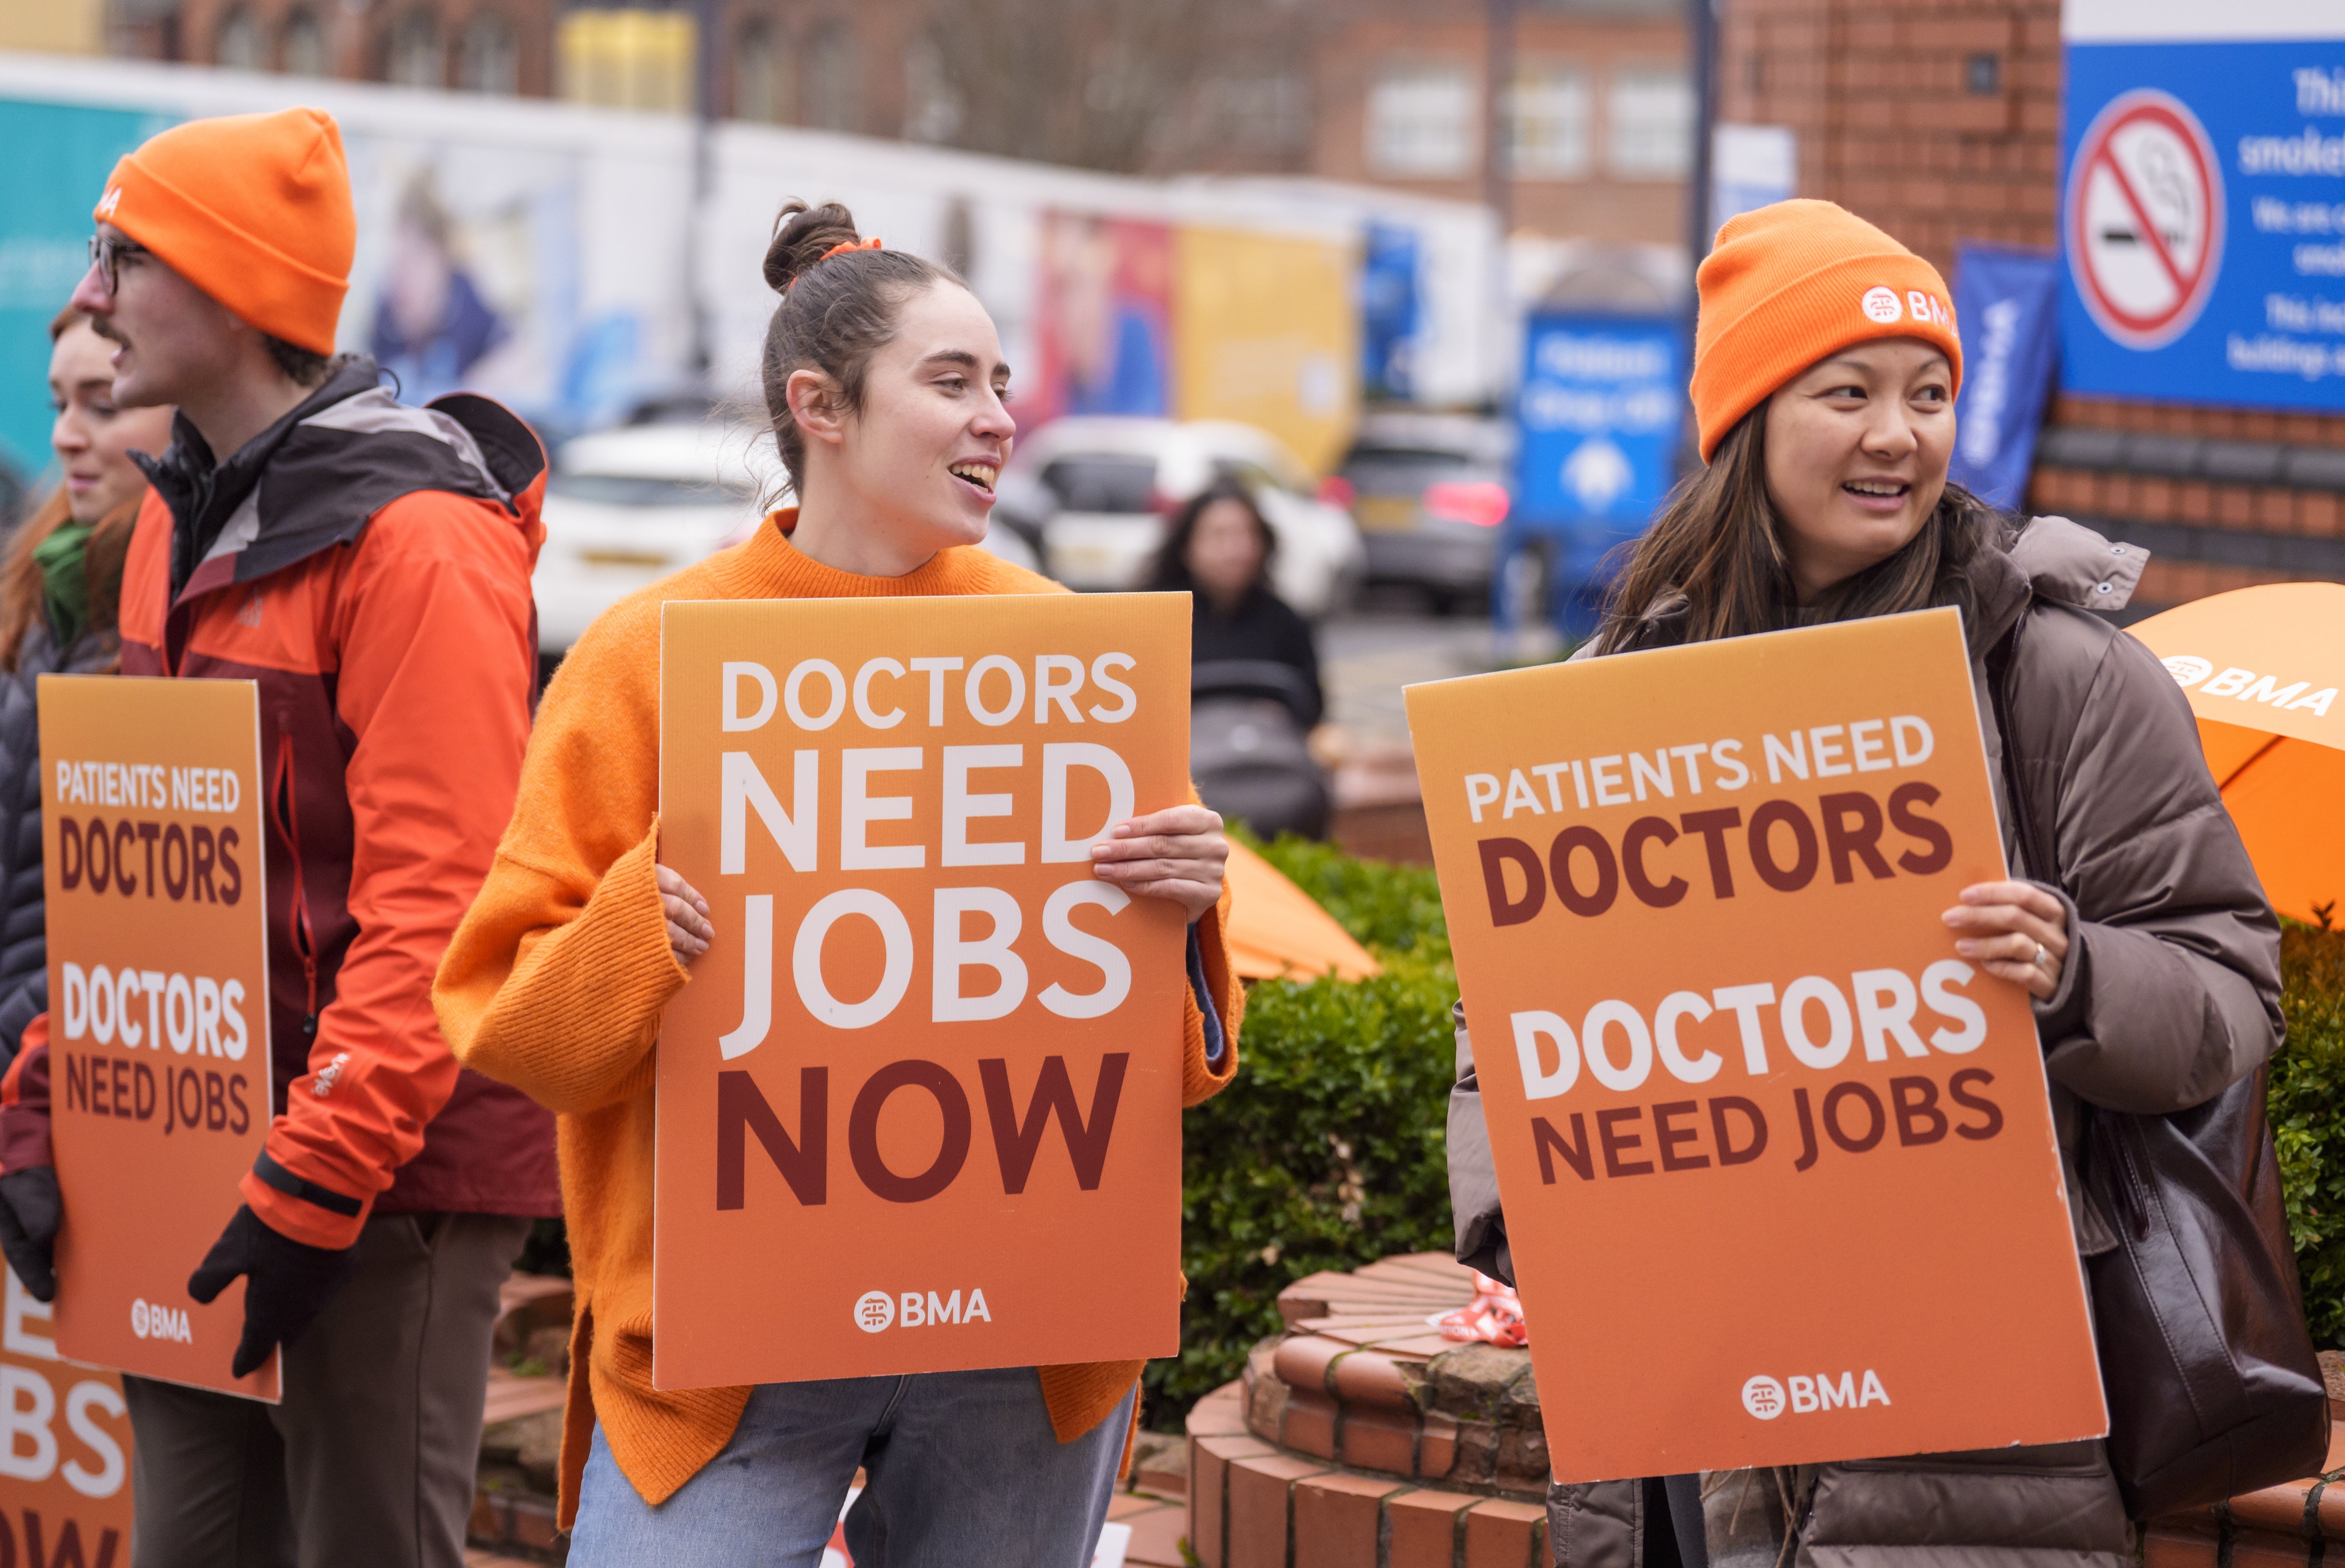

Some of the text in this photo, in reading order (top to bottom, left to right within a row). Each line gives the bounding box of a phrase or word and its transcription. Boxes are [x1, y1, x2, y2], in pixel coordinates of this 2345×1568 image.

[721, 652, 1137, 732] DOCTORS
[2199, 667, 2338, 716] BMA
[57, 760, 240, 813] PATIENTS NEED
[720, 742, 1135, 875] NEED
[1465, 715, 1935, 823] PATIENTS NEED
[59, 815, 242, 906] DOCTORS
[1477, 781, 1953, 928] DOCTORS
[62, 962, 248, 1061] DOCTORS
[718, 880, 1132, 1061] JOBS
[1510, 959, 1988, 1101] DOCTORS
[66, 1052, 156, 1122] NEED
[164, 1064, 250, 1137] JOBS
[716, 1052, 1130, 1211] NOW
[1531, 1067, 2005, 1186] NEED JOBS
[151, 1304, 193, 1345] BMA
[900, 1288, 992, 1328] BMA
[1788, 1369, 1892, 1413] BMA
